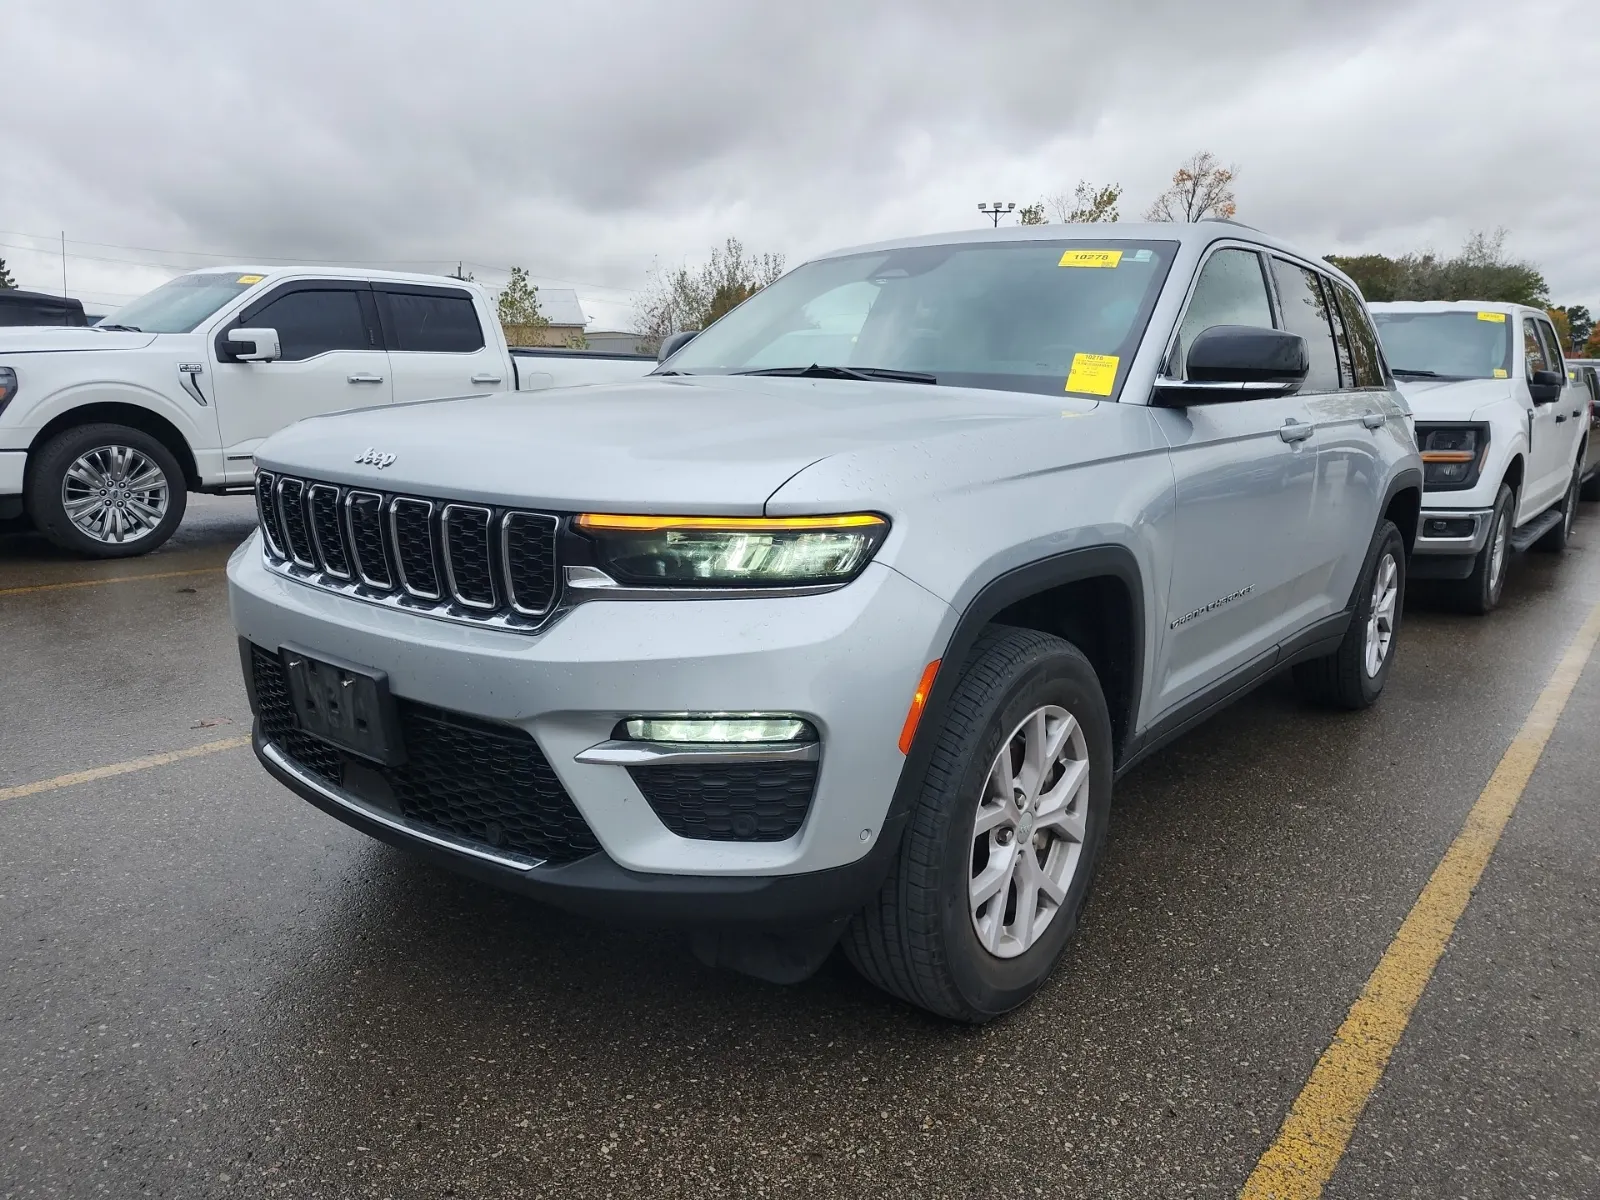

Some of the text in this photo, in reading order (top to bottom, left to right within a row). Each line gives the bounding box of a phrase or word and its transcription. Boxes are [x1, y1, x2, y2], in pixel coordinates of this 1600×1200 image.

[354, 447, 397, 470] Jeep
[1170, 583, 1256, 630] GRAND CHEROKEE
